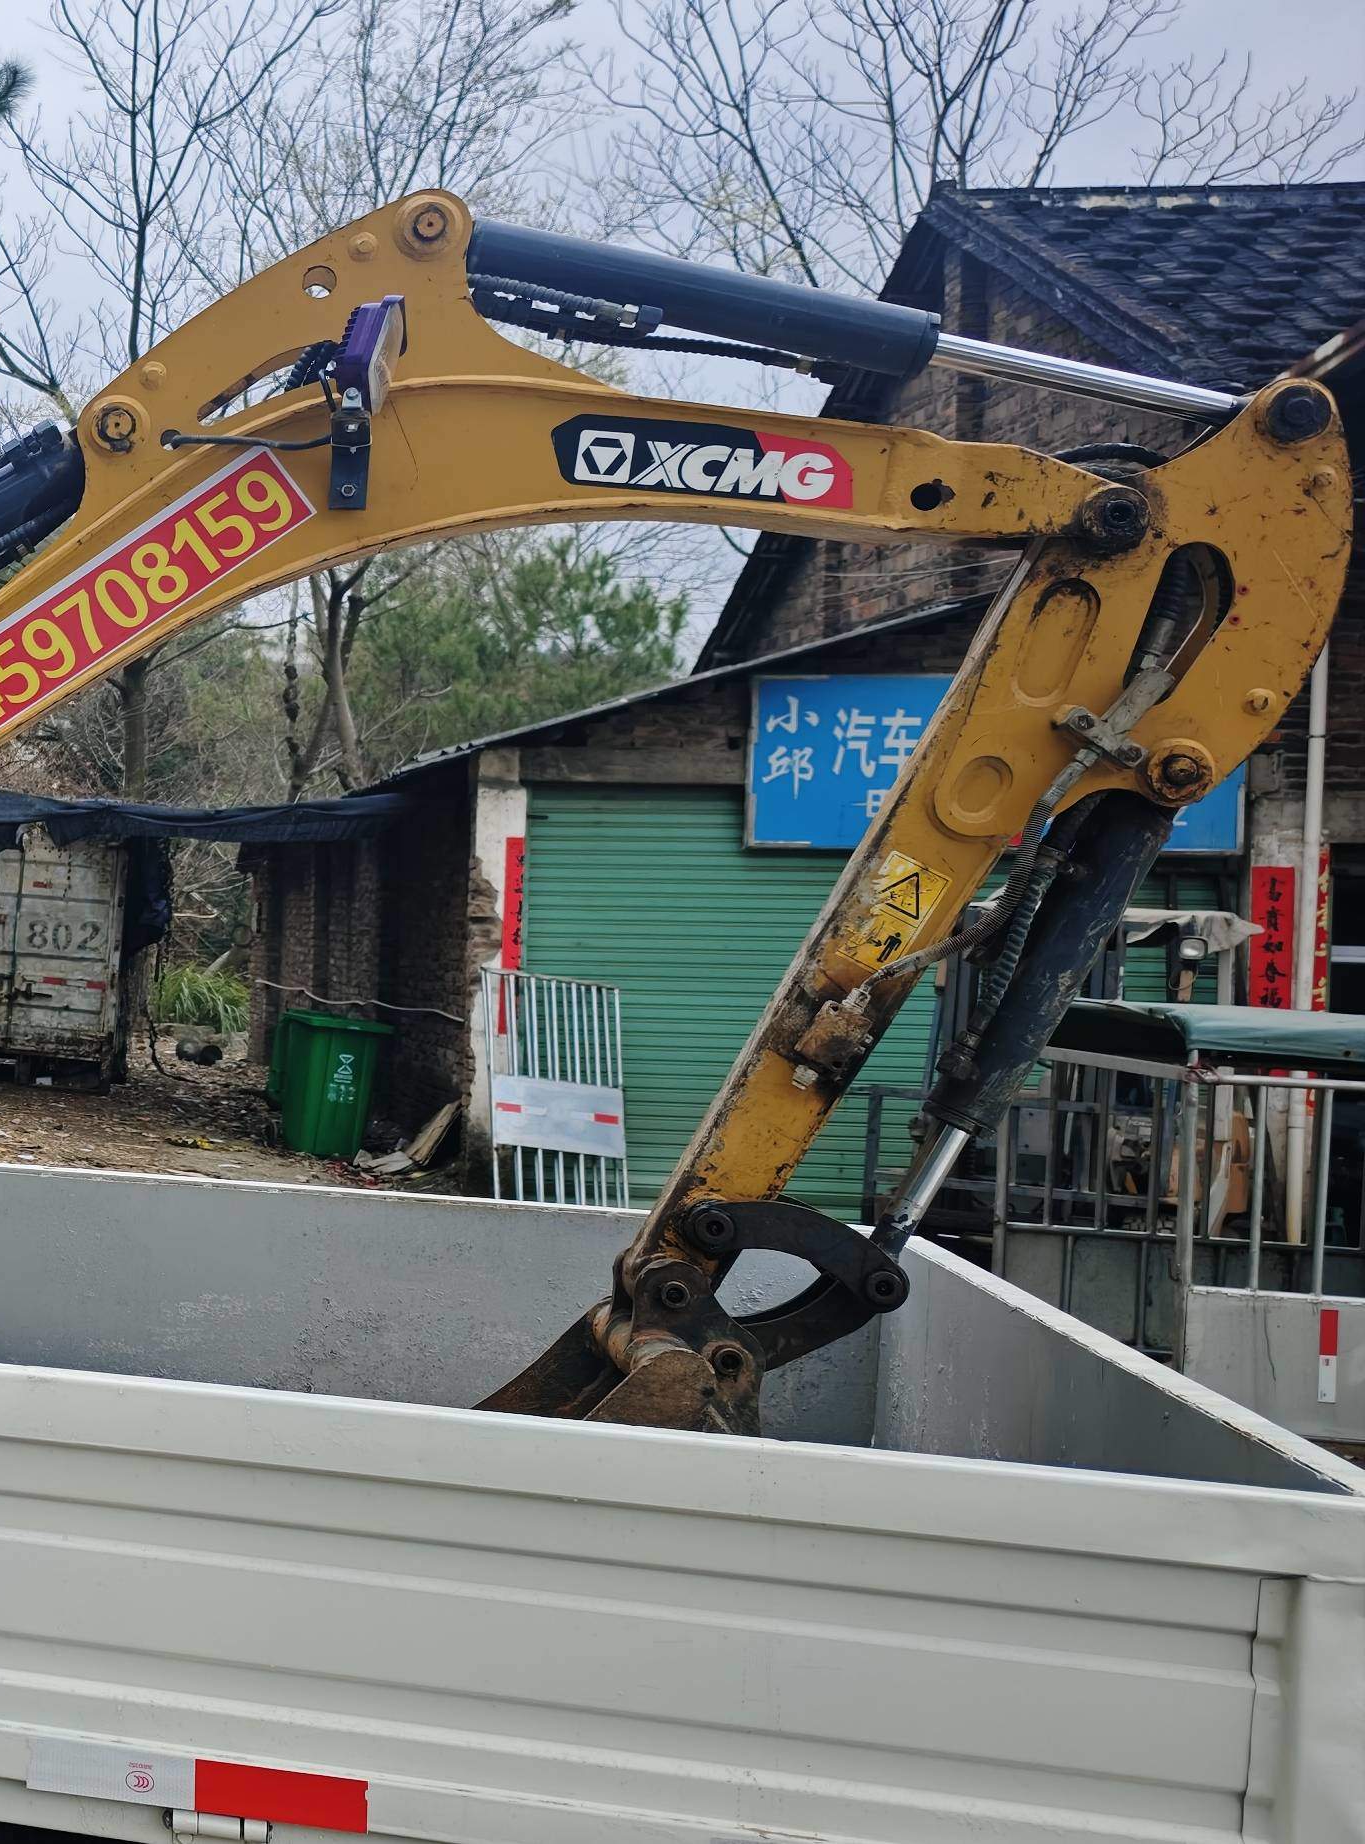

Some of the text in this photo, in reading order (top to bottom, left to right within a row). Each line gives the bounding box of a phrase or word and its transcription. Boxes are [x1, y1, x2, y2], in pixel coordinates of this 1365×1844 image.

[628, 440, 835, 501] XCMG
[762, 695, 819, 799] 小邱
[832, 708, 922, 779] 汽车
[27, 919, 102, 951] 802
